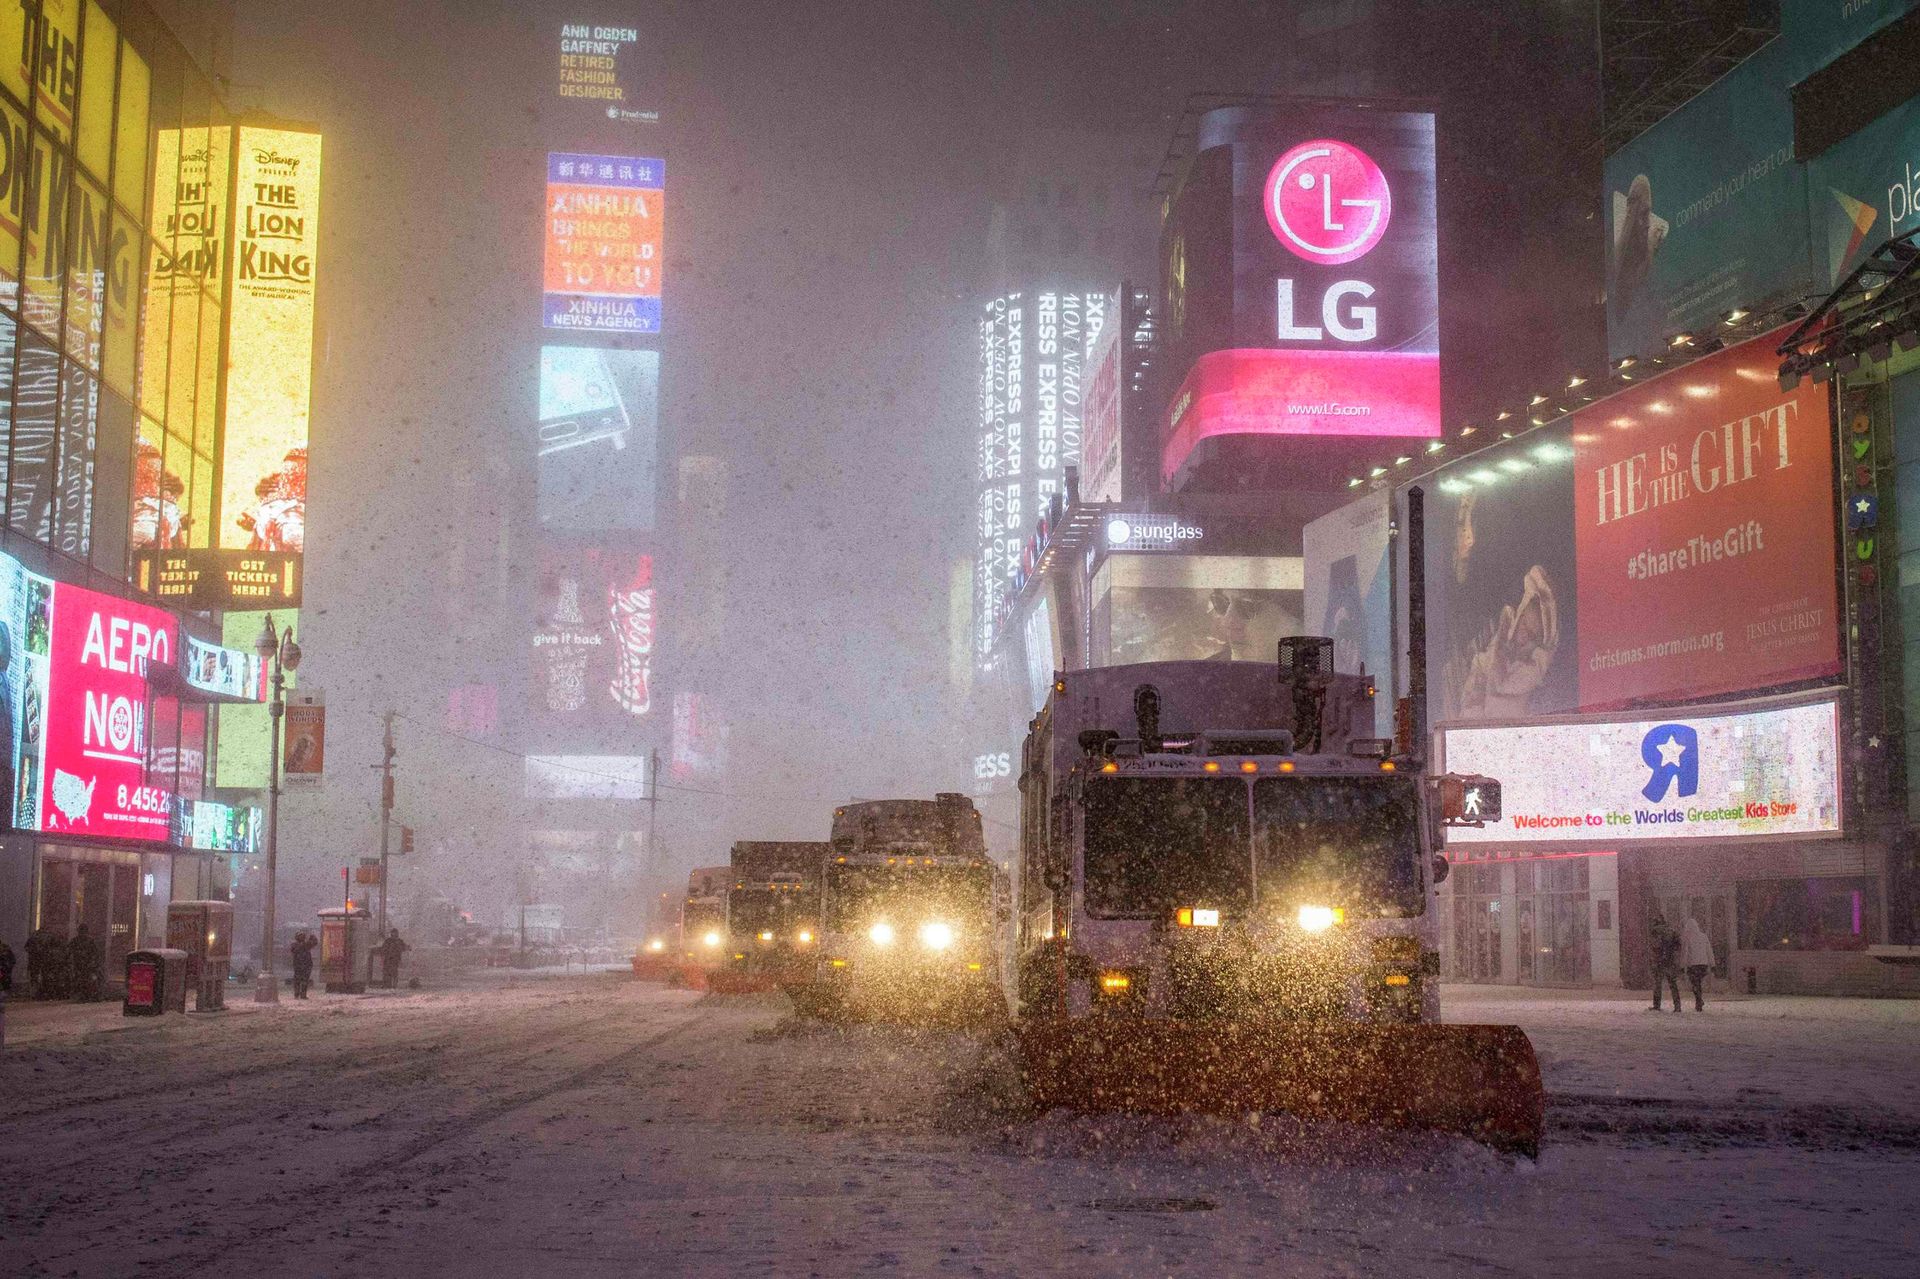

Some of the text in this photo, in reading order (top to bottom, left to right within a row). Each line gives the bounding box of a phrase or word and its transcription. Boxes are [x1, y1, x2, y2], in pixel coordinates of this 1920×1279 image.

[561, 25, 637, 42] ANN OGDEN
[19, 0, 75, 114] THE
[561, 39, 619, 55] GAFFNEY
[560, 54, 614, 69] RETIRED
[560, 70, 615, 84] FASHION
[254, 183, 296, 203] THE
[552, 193, 649, 218] XINHUA
[246, 206, 304, 238] LION
[553, 219, 630, 239] BRINGS
[239, 241, 311, 280] KING
[561, 261, 651, 288] TO YOU
[569, 300, 636, 317] XINHUA
[1278, 279, 1376, 341] LG
[553, 314, 651, 329] NEWS AGENCY
[1008, 308, 1022, 415] EXPRESS
[1062, 293, 1081, 464] NOW OPEN NOW
[1038, 364, 1058, 470] EXPRESS
[1288, 403, 1371, 416] www.LG.com
[1595, 400, 1799, 526] HE IS THE GIFT
[1134, 522, 1204, 542] sunglass
[1627, 520, 1765, 581] #ShareTheGift
[240, 560, 266, 571] GET
[226, 571, 278, 583] TICKETS
[232, 585, 271, 596] HERE!
[1780, 609, 1824, 635] CHRIST
[533, 632, 602, 646] give it back
[1590, 631, 1725, 672] christmas.mormon.org
[1513, 801, 1797, 829] Welcome to the Worlds Greatest Kids Store
